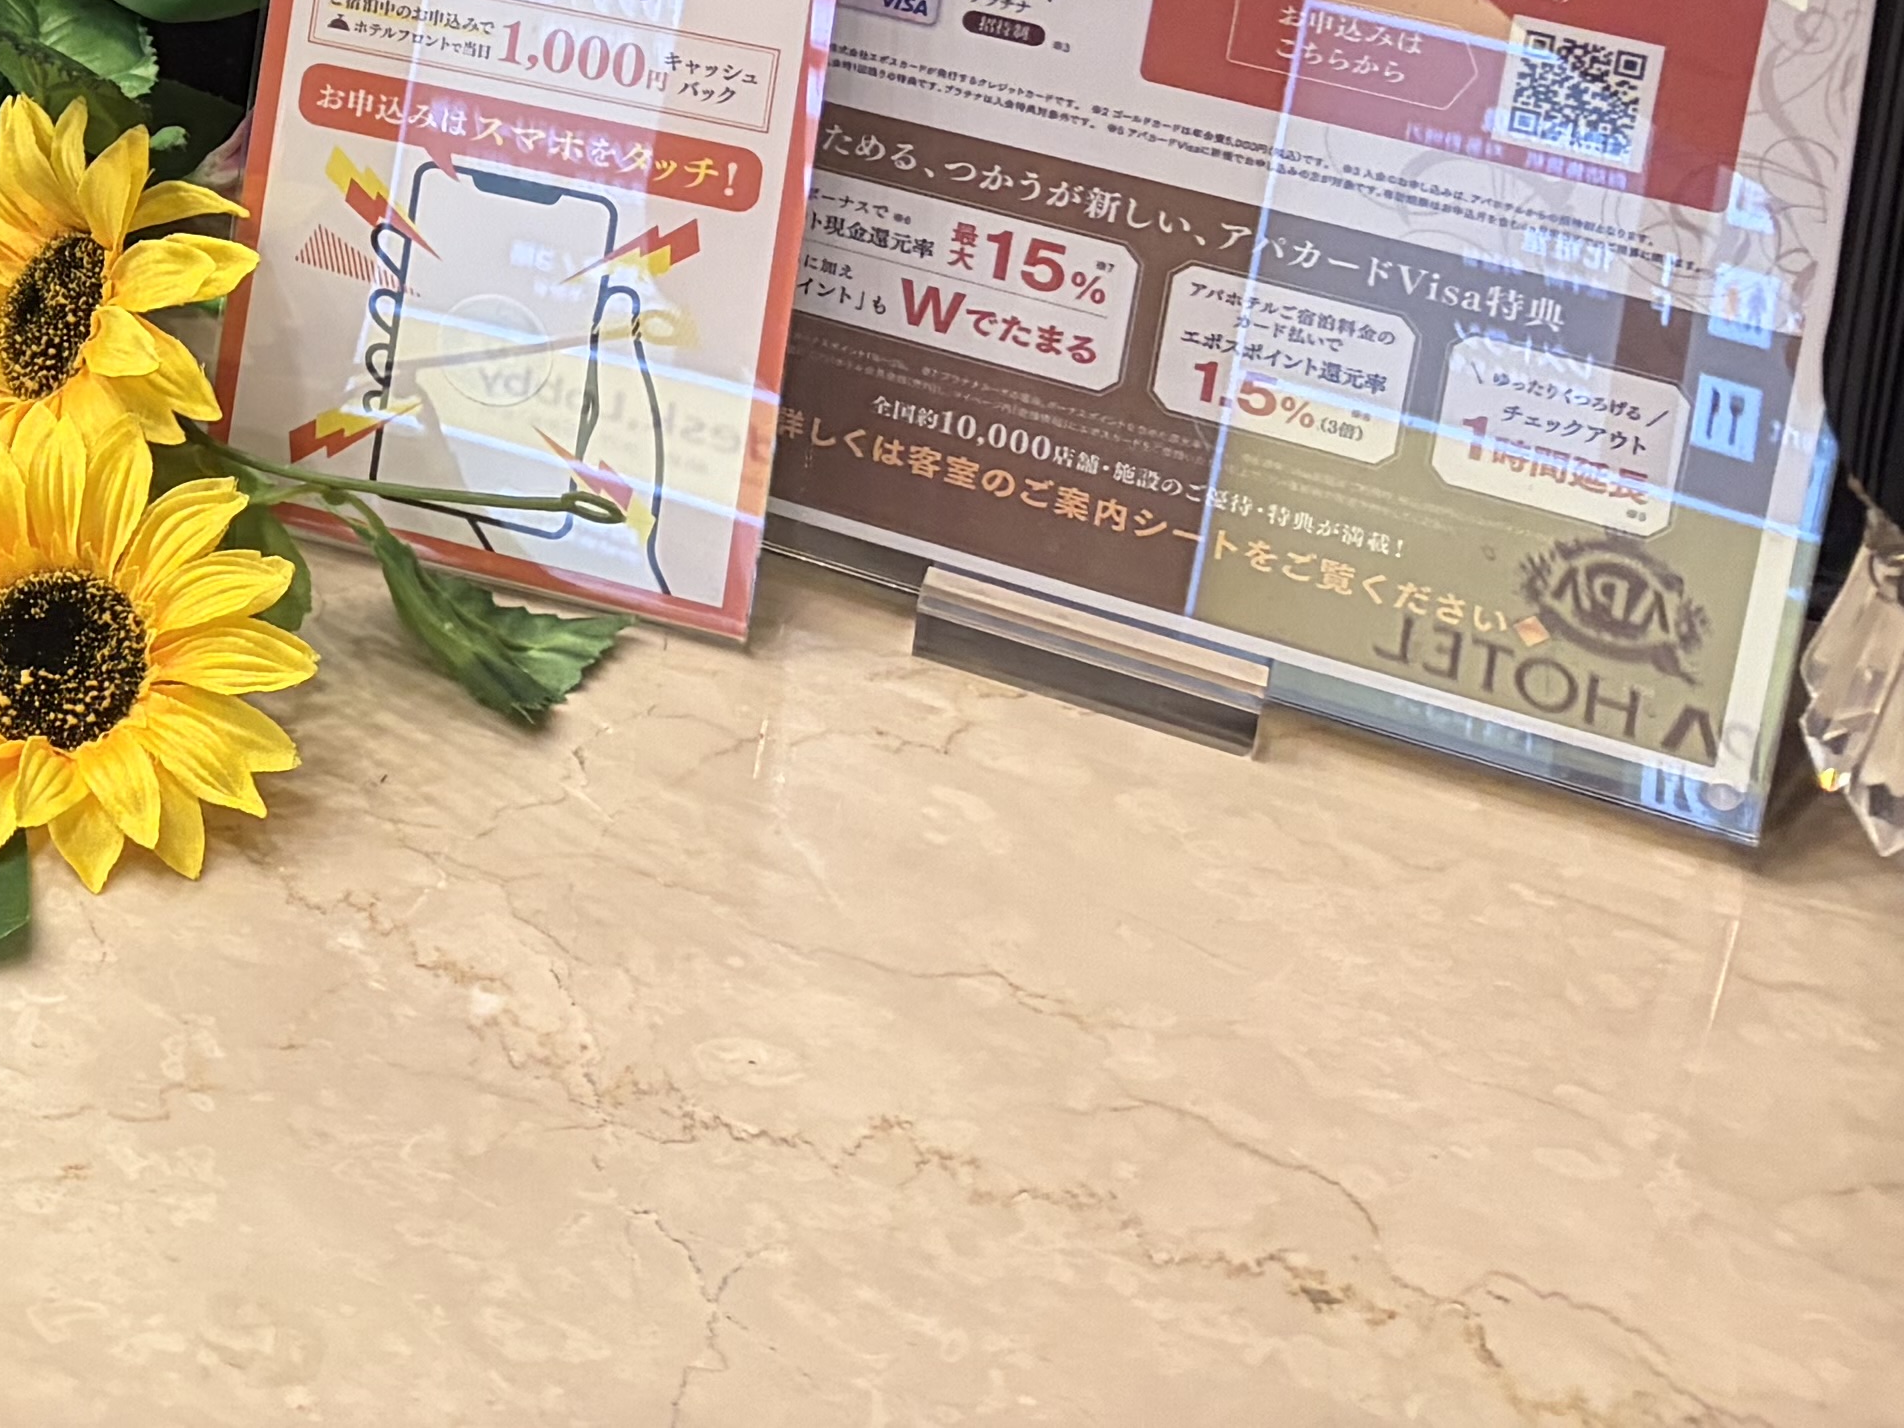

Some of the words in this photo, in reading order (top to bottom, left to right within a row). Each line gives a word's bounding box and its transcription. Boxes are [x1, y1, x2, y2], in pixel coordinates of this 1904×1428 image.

[353, 20, 492, 61] ホテルフロントで当日
[497, 19, 668, 93] 1,000円
[663, 50, 760, 86] キャッシュ
[1277, 6, 1423, 55] お申込みは
[1275, 37, 1407, 85] こちらから
[679, 79, 737, 104] バック
[947, 222, 979, 273] 最大
[988, 230, 1107, 308] 15%
[901, 277, 1098, 365] Wでたまる
[1189, 281, 1396, 346] アパホテルご宿泊料金の
[1233, 315, 1345, 352] カード払いで
[1180, 329, 1388, 394] エポスポイント還元率
[1492, 370, 1643, 424] ゆったりくつろげる
[1503, 403, 1650, 456] チェックアウト
[1461, 414, 1651, 508] 1時間延長
[777, 405, 1509, 634] 詳しくは客室のご案内シートをご覧ください
